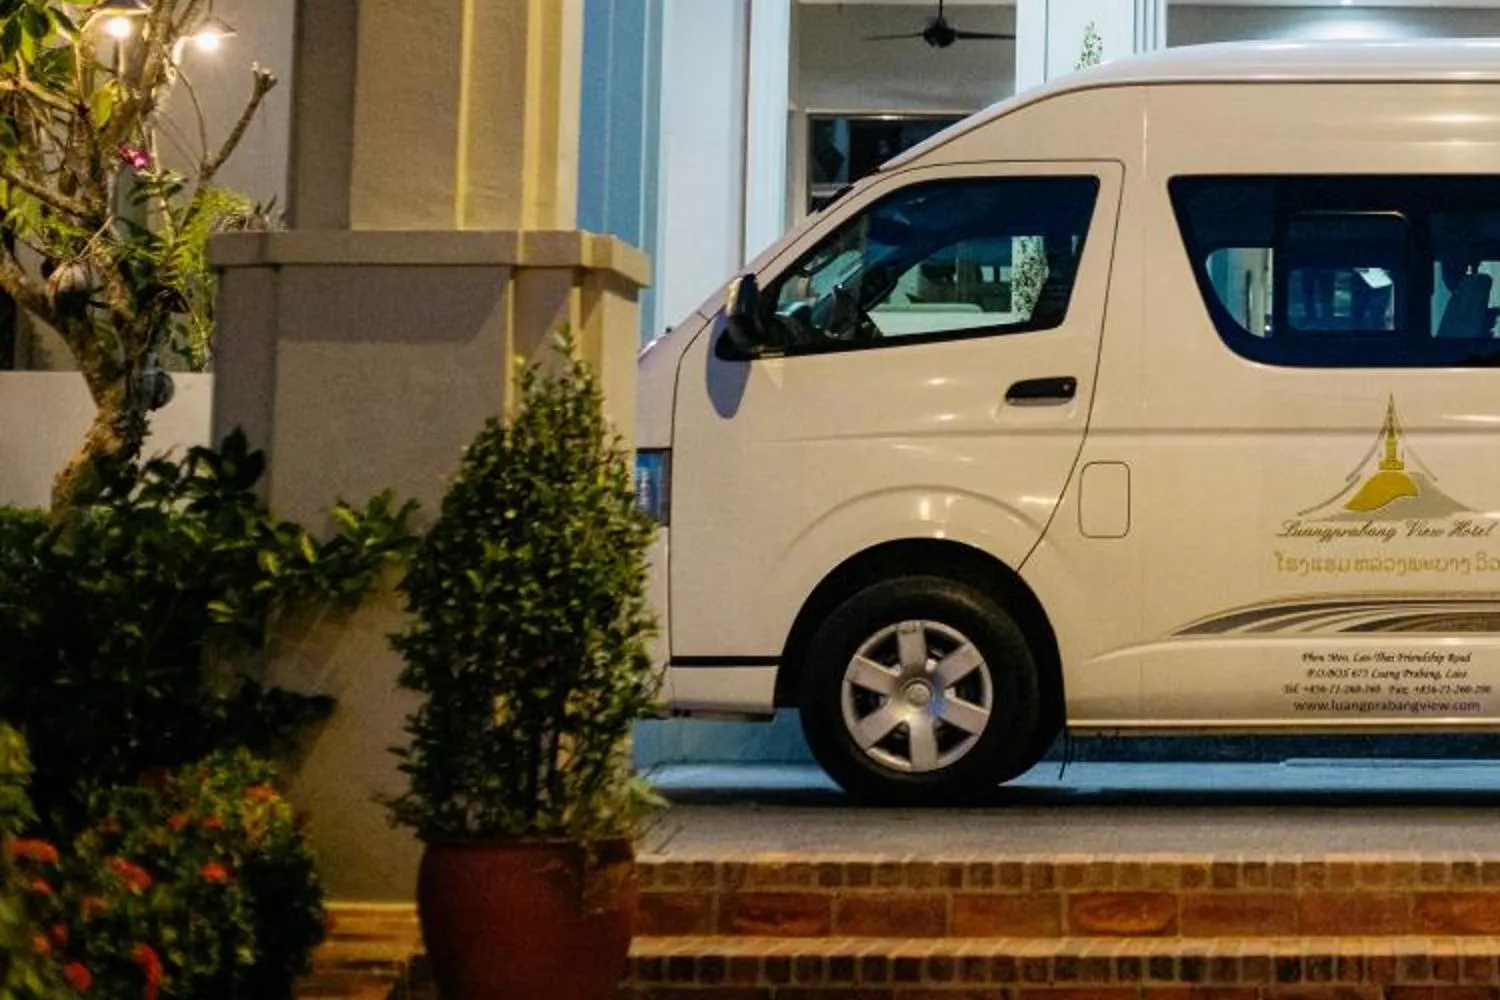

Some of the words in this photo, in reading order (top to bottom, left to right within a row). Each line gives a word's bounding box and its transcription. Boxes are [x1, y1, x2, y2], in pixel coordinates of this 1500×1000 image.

[1275, 518, 1397, 543] Luangprabang
[1405, 518, 1446, 538] View
[1446, 519, 1498, 538] Hotel
[1292, 699, 1481, 715] www.luangprabangview.com
